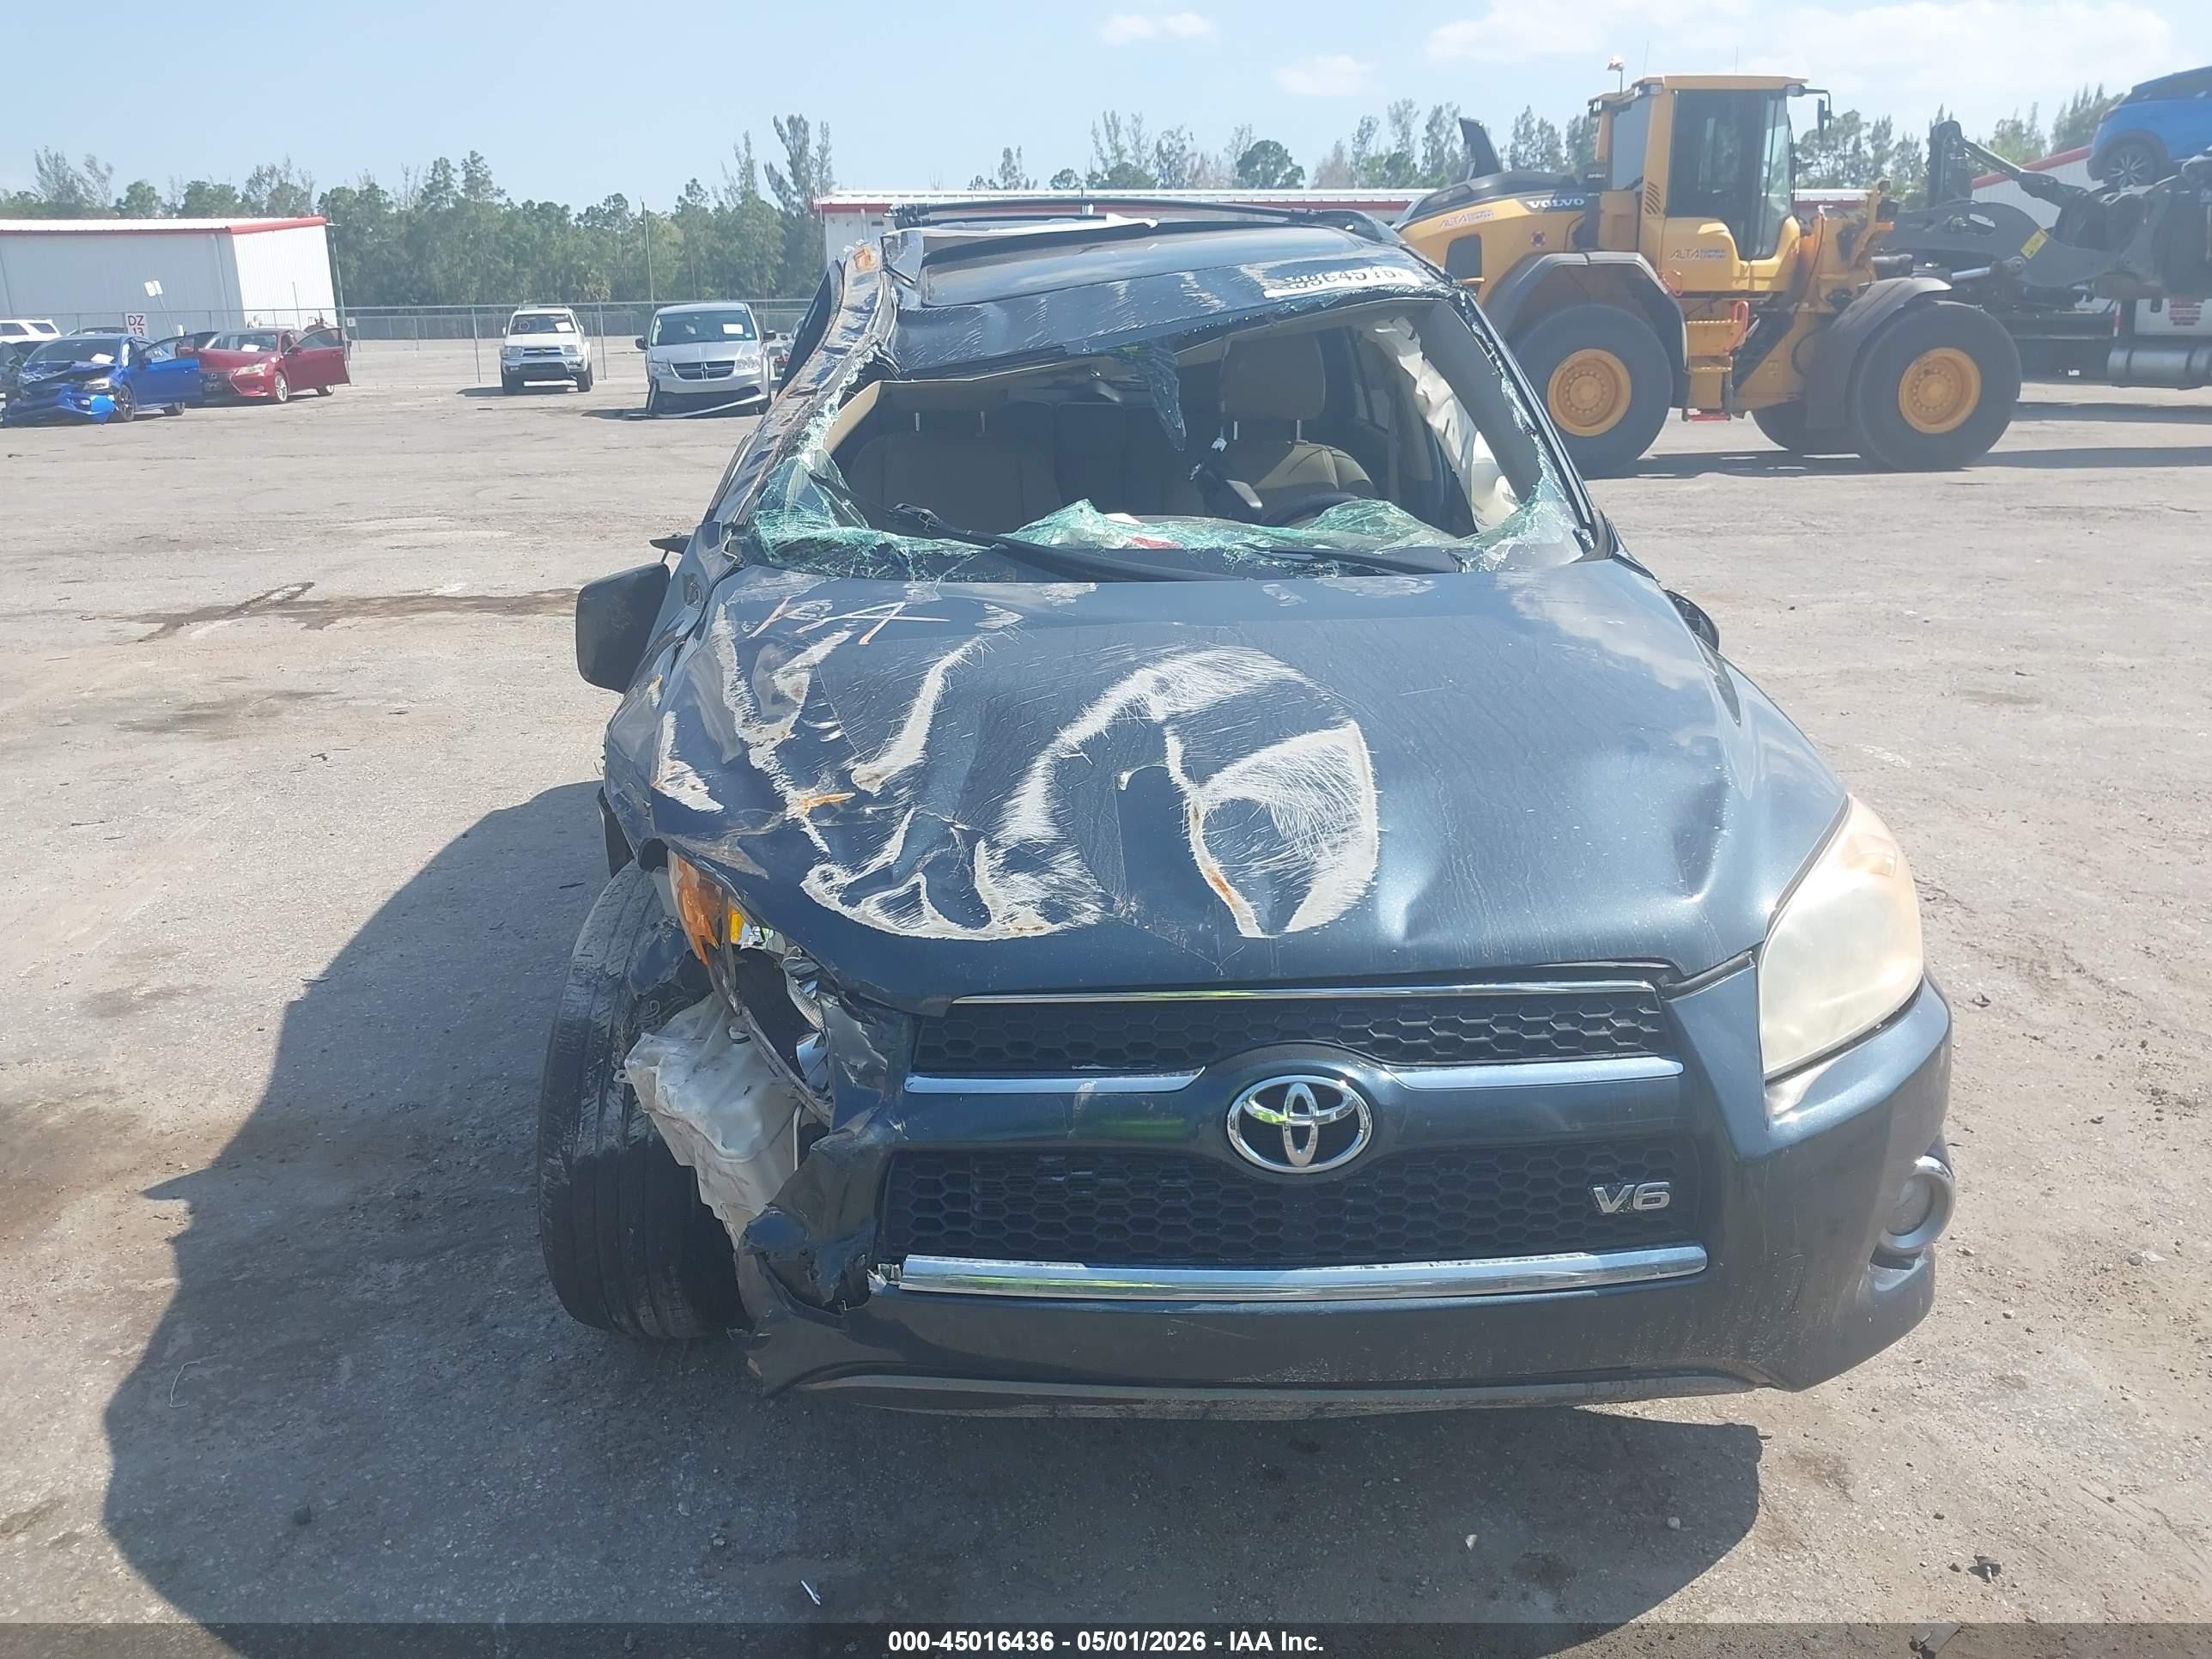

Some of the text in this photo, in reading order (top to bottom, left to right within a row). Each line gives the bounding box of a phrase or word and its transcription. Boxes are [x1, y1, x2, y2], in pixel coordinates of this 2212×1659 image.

[1526, 198, 1584, 209] VOLVO
[1439, 214, 1467, 229] ALTA
[1669, 248, 1698, 259] ALTA
[128, 315, 144, 326] DZ
[1593, 1182, 1670, 1212] V6
